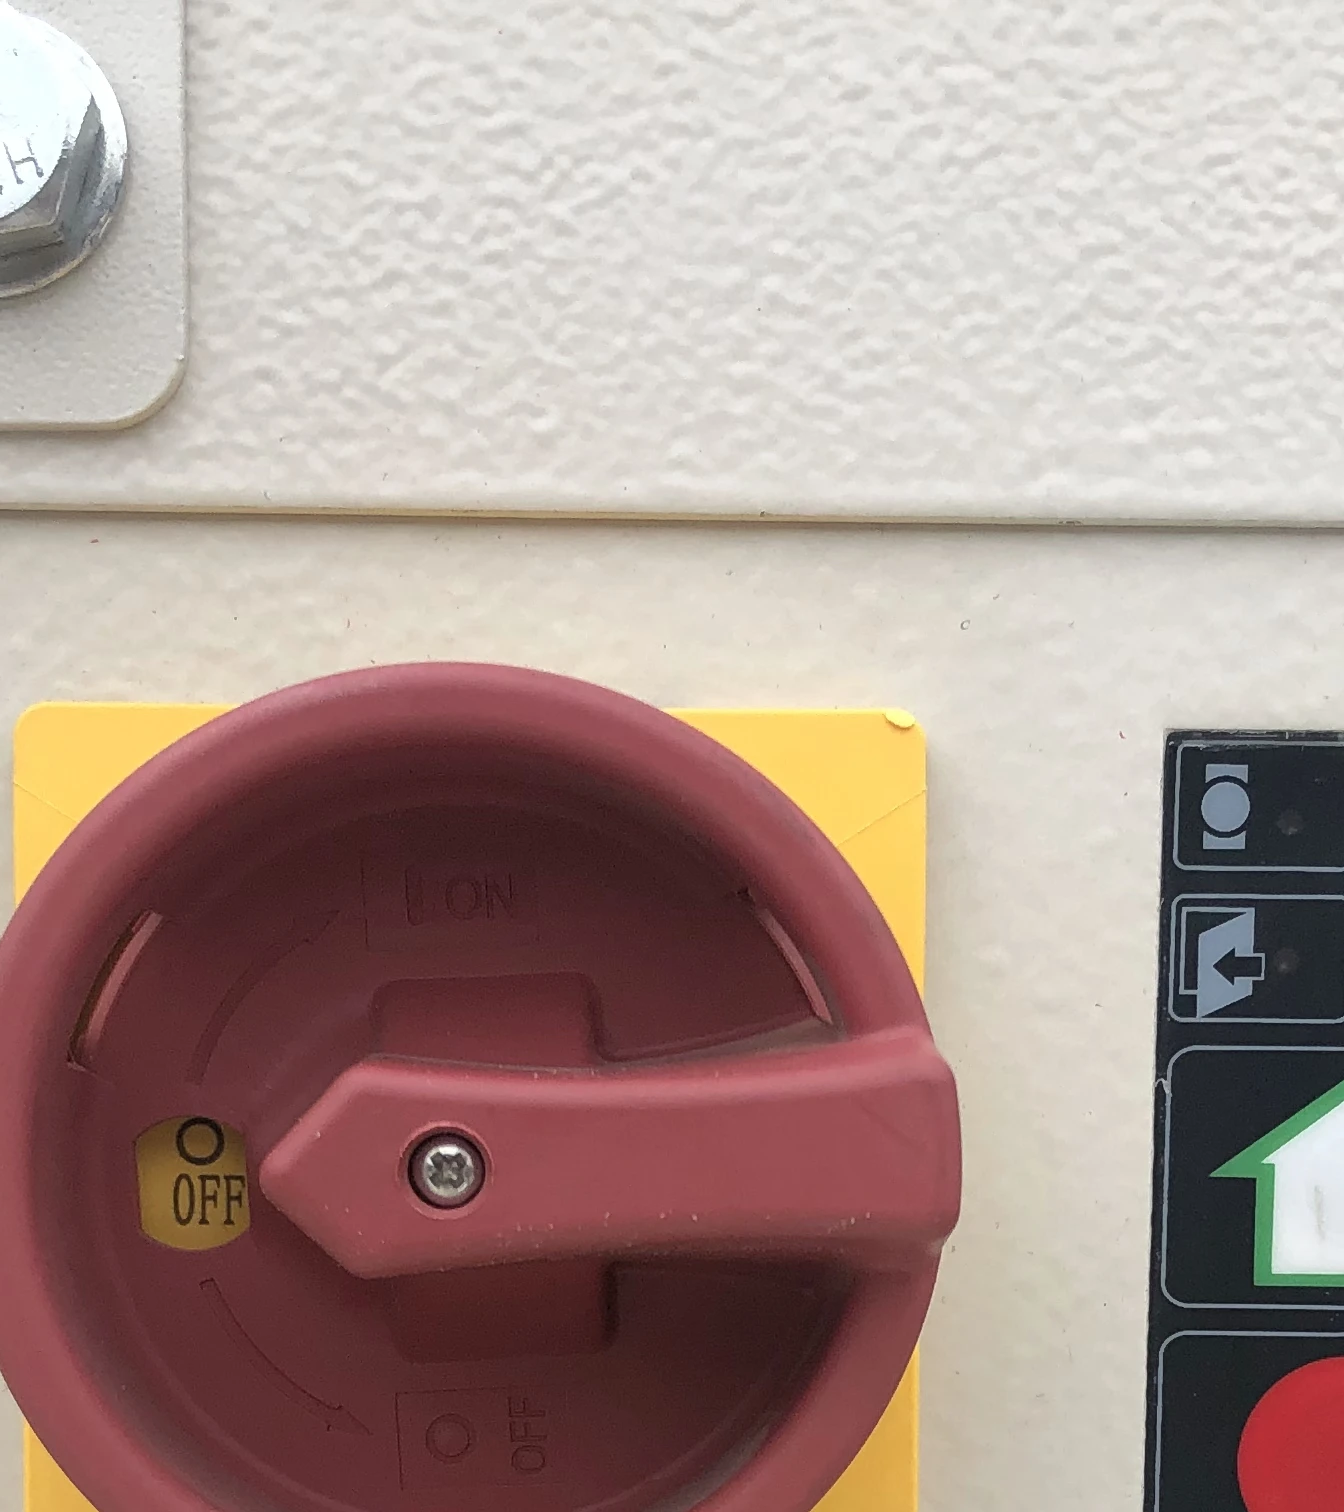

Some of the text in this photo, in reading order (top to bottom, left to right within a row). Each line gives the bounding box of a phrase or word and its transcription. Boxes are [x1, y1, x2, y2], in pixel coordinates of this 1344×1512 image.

[444, 872, 515, 920] ON
[173, 1172, 246, 1226] OFF
[508, 1397, 548, 1474] OFF
